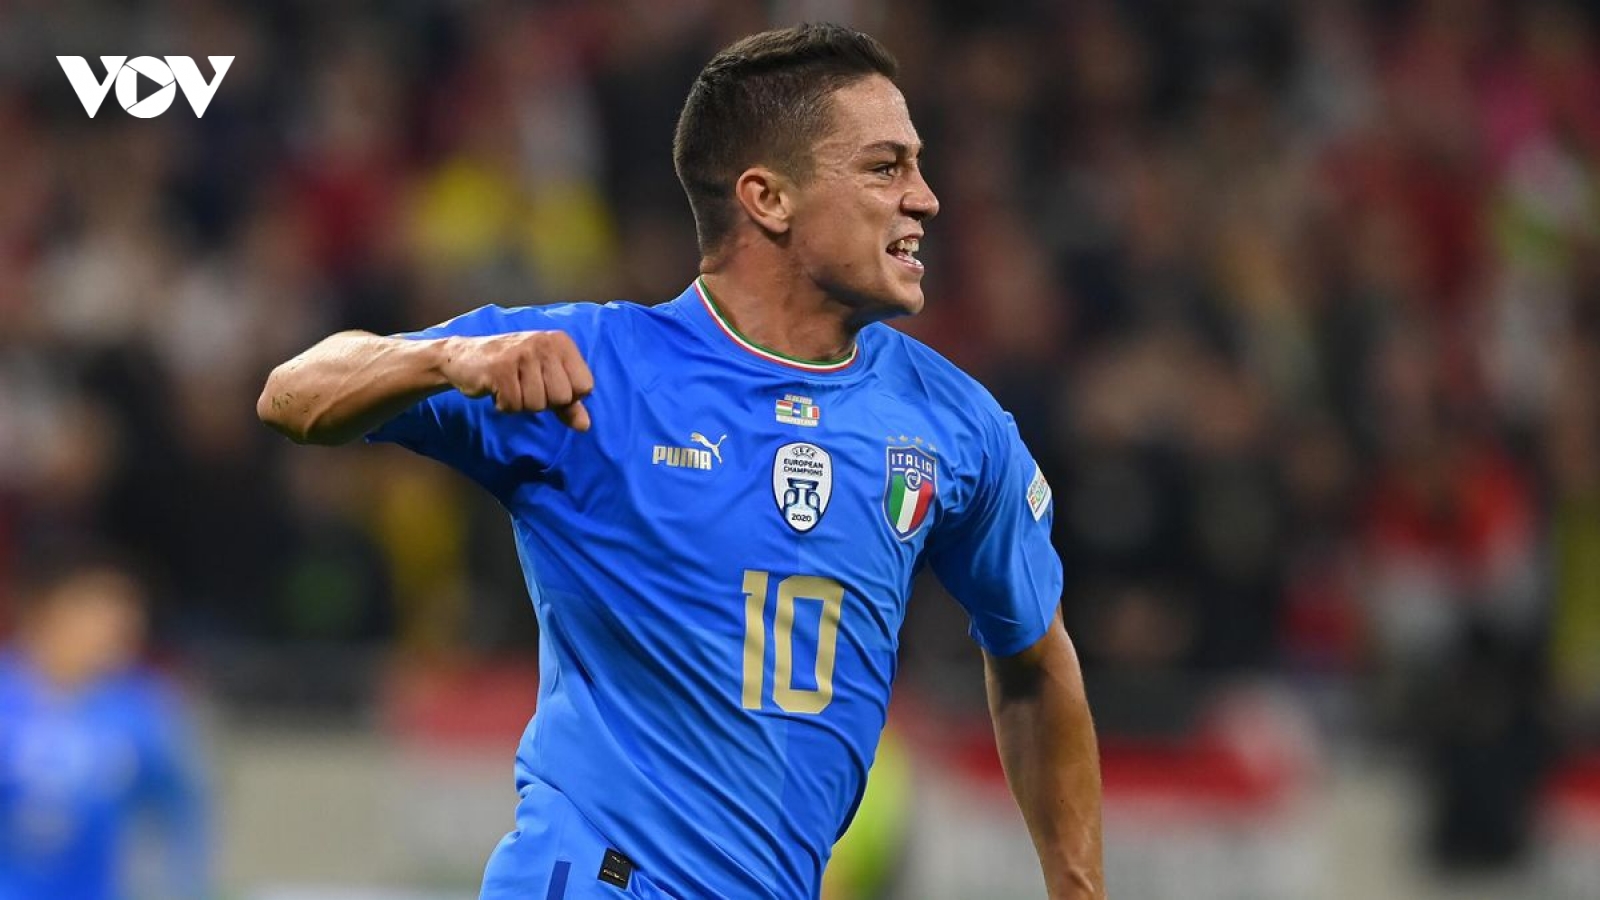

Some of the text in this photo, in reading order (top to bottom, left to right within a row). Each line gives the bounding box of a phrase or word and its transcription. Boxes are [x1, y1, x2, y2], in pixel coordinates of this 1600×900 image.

[652, 445, 712, 470] PUMA
[783, 458, 824, 469] EUROPEAN
[891, 452, 933, 475] ITALIA
[783, 466, 824, 477] CHAMPIONS
[791, 512, 812, 522] 2020
[742, 569, 845, 715] 10
